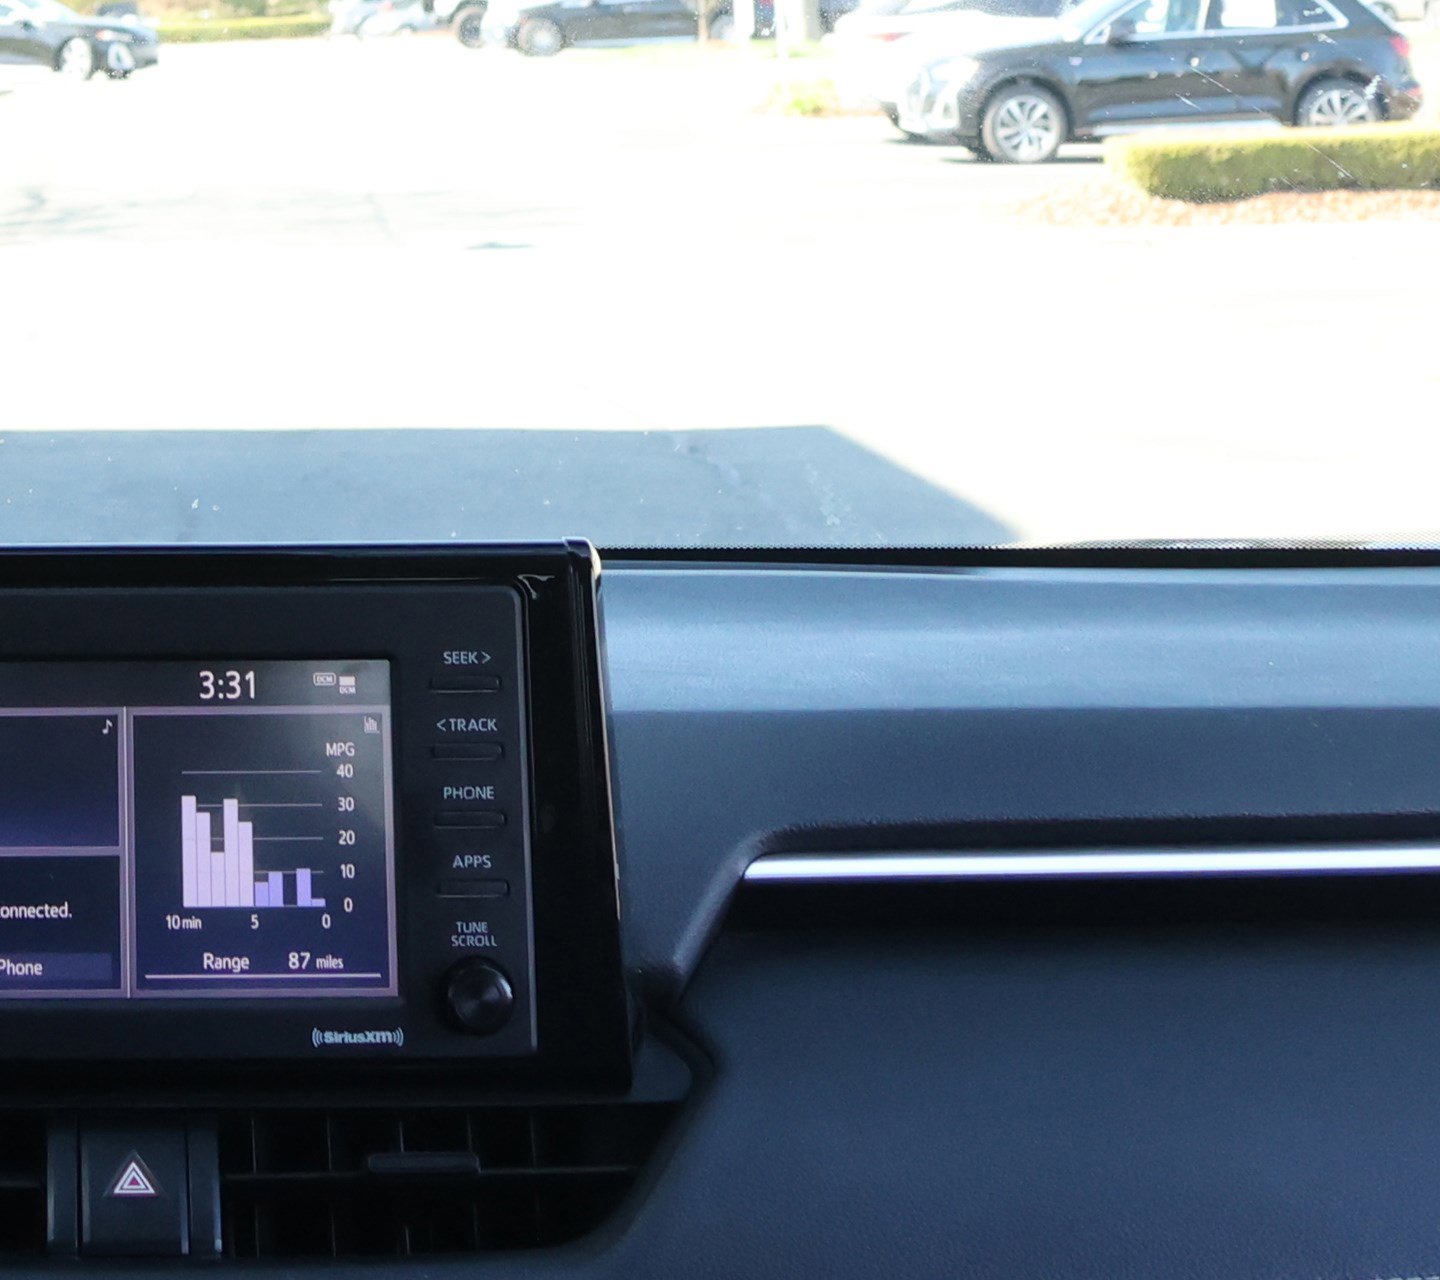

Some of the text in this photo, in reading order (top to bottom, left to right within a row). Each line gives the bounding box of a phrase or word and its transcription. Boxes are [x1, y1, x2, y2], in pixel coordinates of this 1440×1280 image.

[442, 650, 479, 665] SEEK
[199, 670, 256, 700] 3:31
[449, 718, 499, 732] TRACK
[325, 742, 356, 758] MPG
[336, 763, 354, 778] 40
[443, 785, 495, 800] PHONE
[337, 796, 355, 812] 30
[338, 829, 355, 845] 20
[452, 854, 492, 869] APPS
[340, 864, 355, 879] 10
[344, 897, 354, 913] 0
[250, 914, 260, 930] 5
[322, 913, 332, 930] 0
[455, 920, 489, 933] TUNE
[450, 934, 498, 947] SCROLL
[203, 951, 345, 972] Range 87 miles
